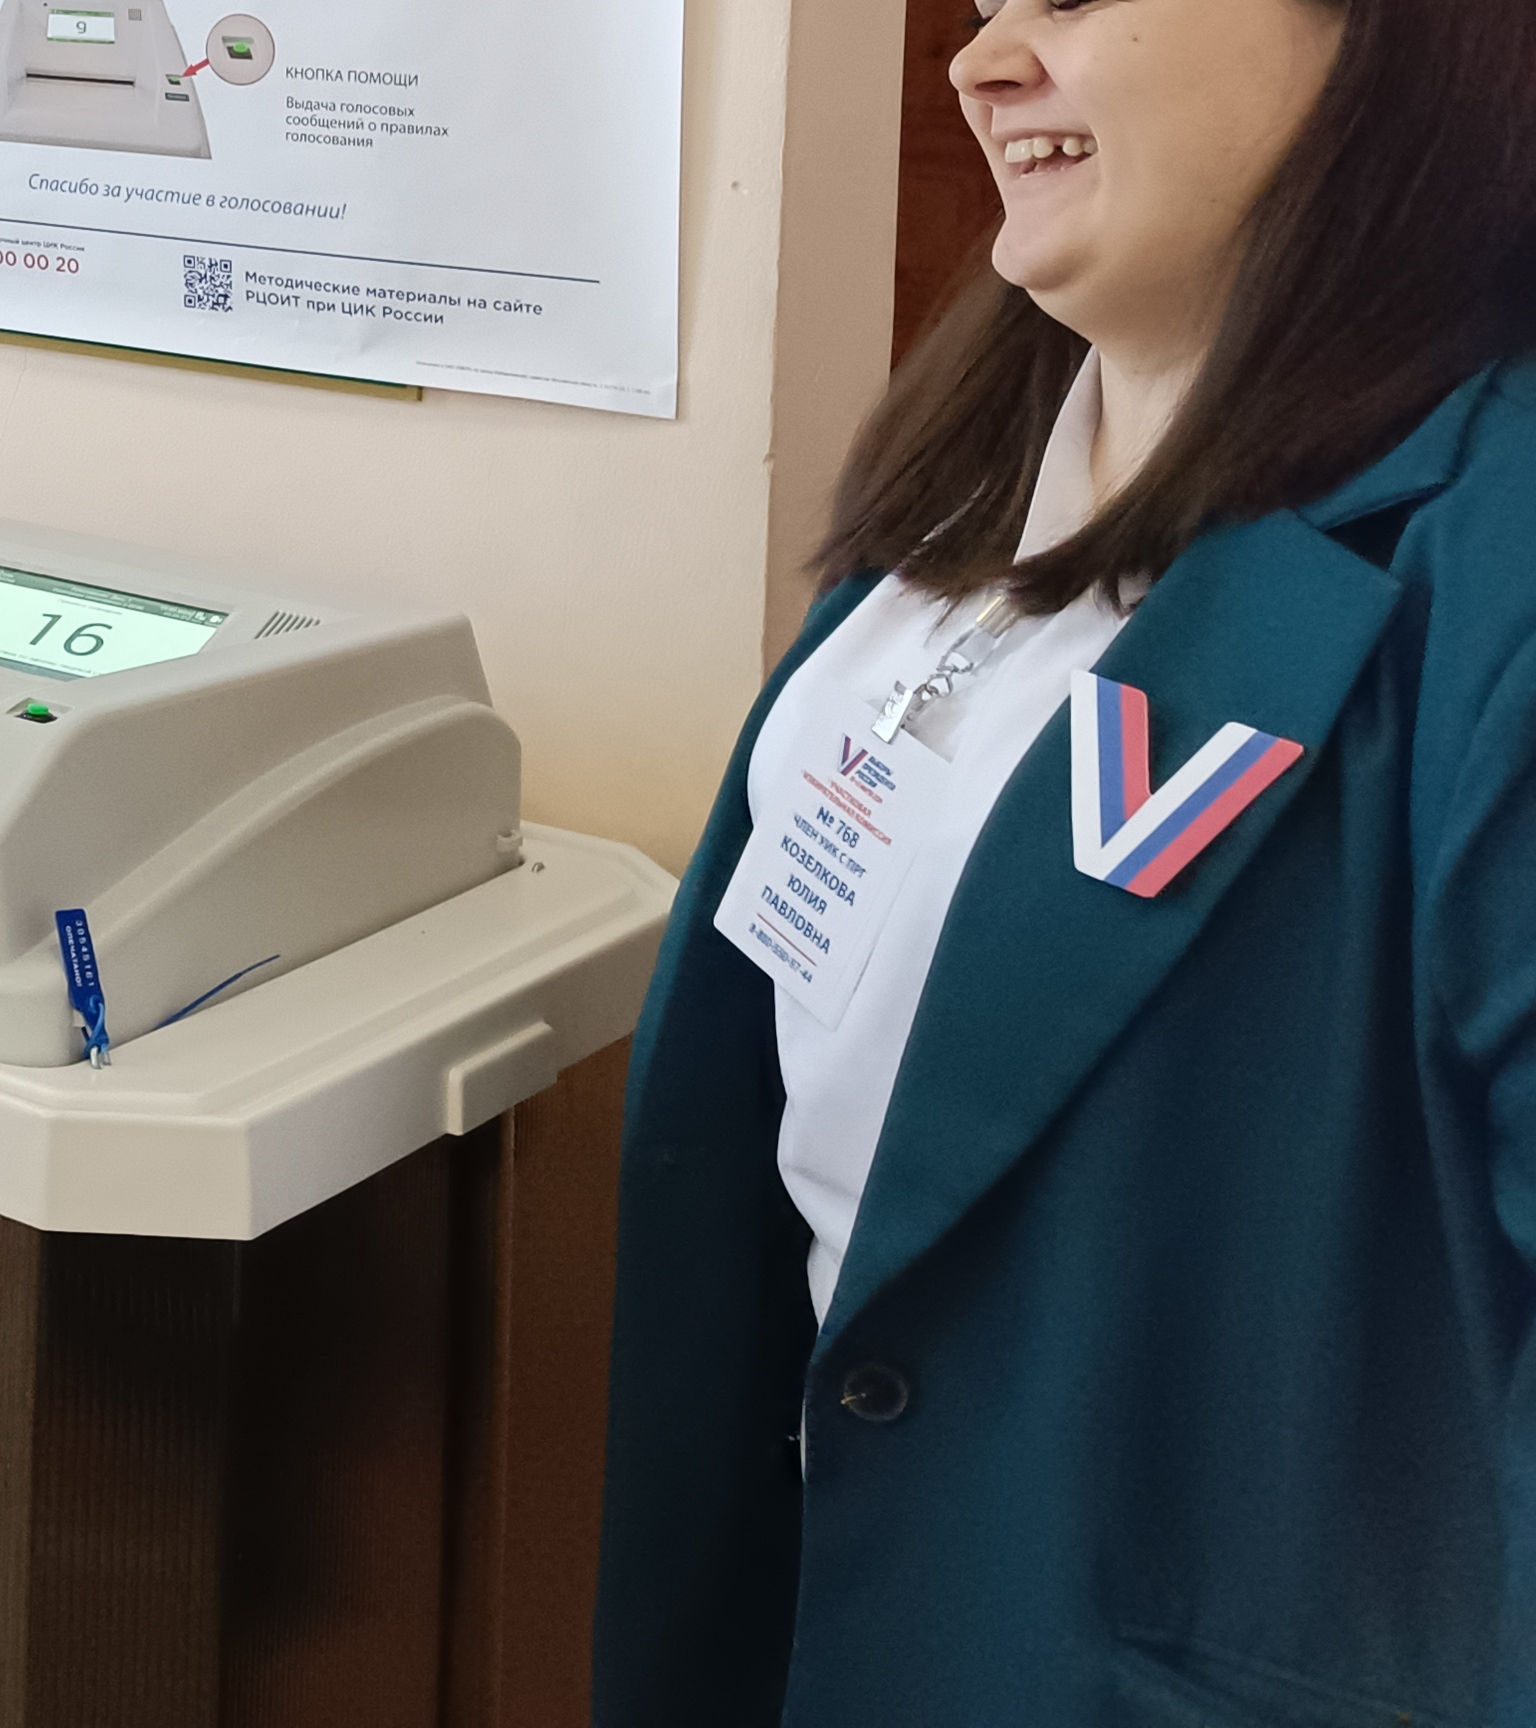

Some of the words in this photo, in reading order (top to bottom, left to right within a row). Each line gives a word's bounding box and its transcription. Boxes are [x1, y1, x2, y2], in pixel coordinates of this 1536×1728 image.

[75, 20, 87, 34] 9
[285, 66, 344, 82] КНОПКА
[347, 70, 419, 88] ПОМОЩИ
[286, 95, 336, 113] Выдача
[340, 102, 415, 117] голосовых
[285, 114, 364, 130] сообщений
[368, 122, 377, 131] о
[380, 122, 449, 137] правилах
[285, 131, 373, 148] голосования
[28, 173, 99, 195] Спасибо
[102, 183, 121, 198] за
[124, 185, 202, 206] участие
[206, 194, 216, 207] в
[219, 194, 347, 220] голосовании!
[23, 252, 49, 270] 00
[55, 256, 80, 274] 20
[245, 270, 361, 296] Методические
[366, 287, 461, 307] материалы
[467, 297, 488, 310] на
[493, 298, 543, 316] сайте
[245, 290, 301, 309] РЦОИТ
[307, 297, 336, 313] при
[341, 301, 376, 318] ЦИК
[382, 305, 444, 324] России
[28, 613, 113, 656] 16
[816, 806, 836, 828] №
[837, 819, 861, 850] 768
[780, 835, 857, 907] КОЗЕЛКОВА
[787, 874, 828, 916] ЮЛИЯ
[761, 884, 831, 955] ПАВЛОВНА
